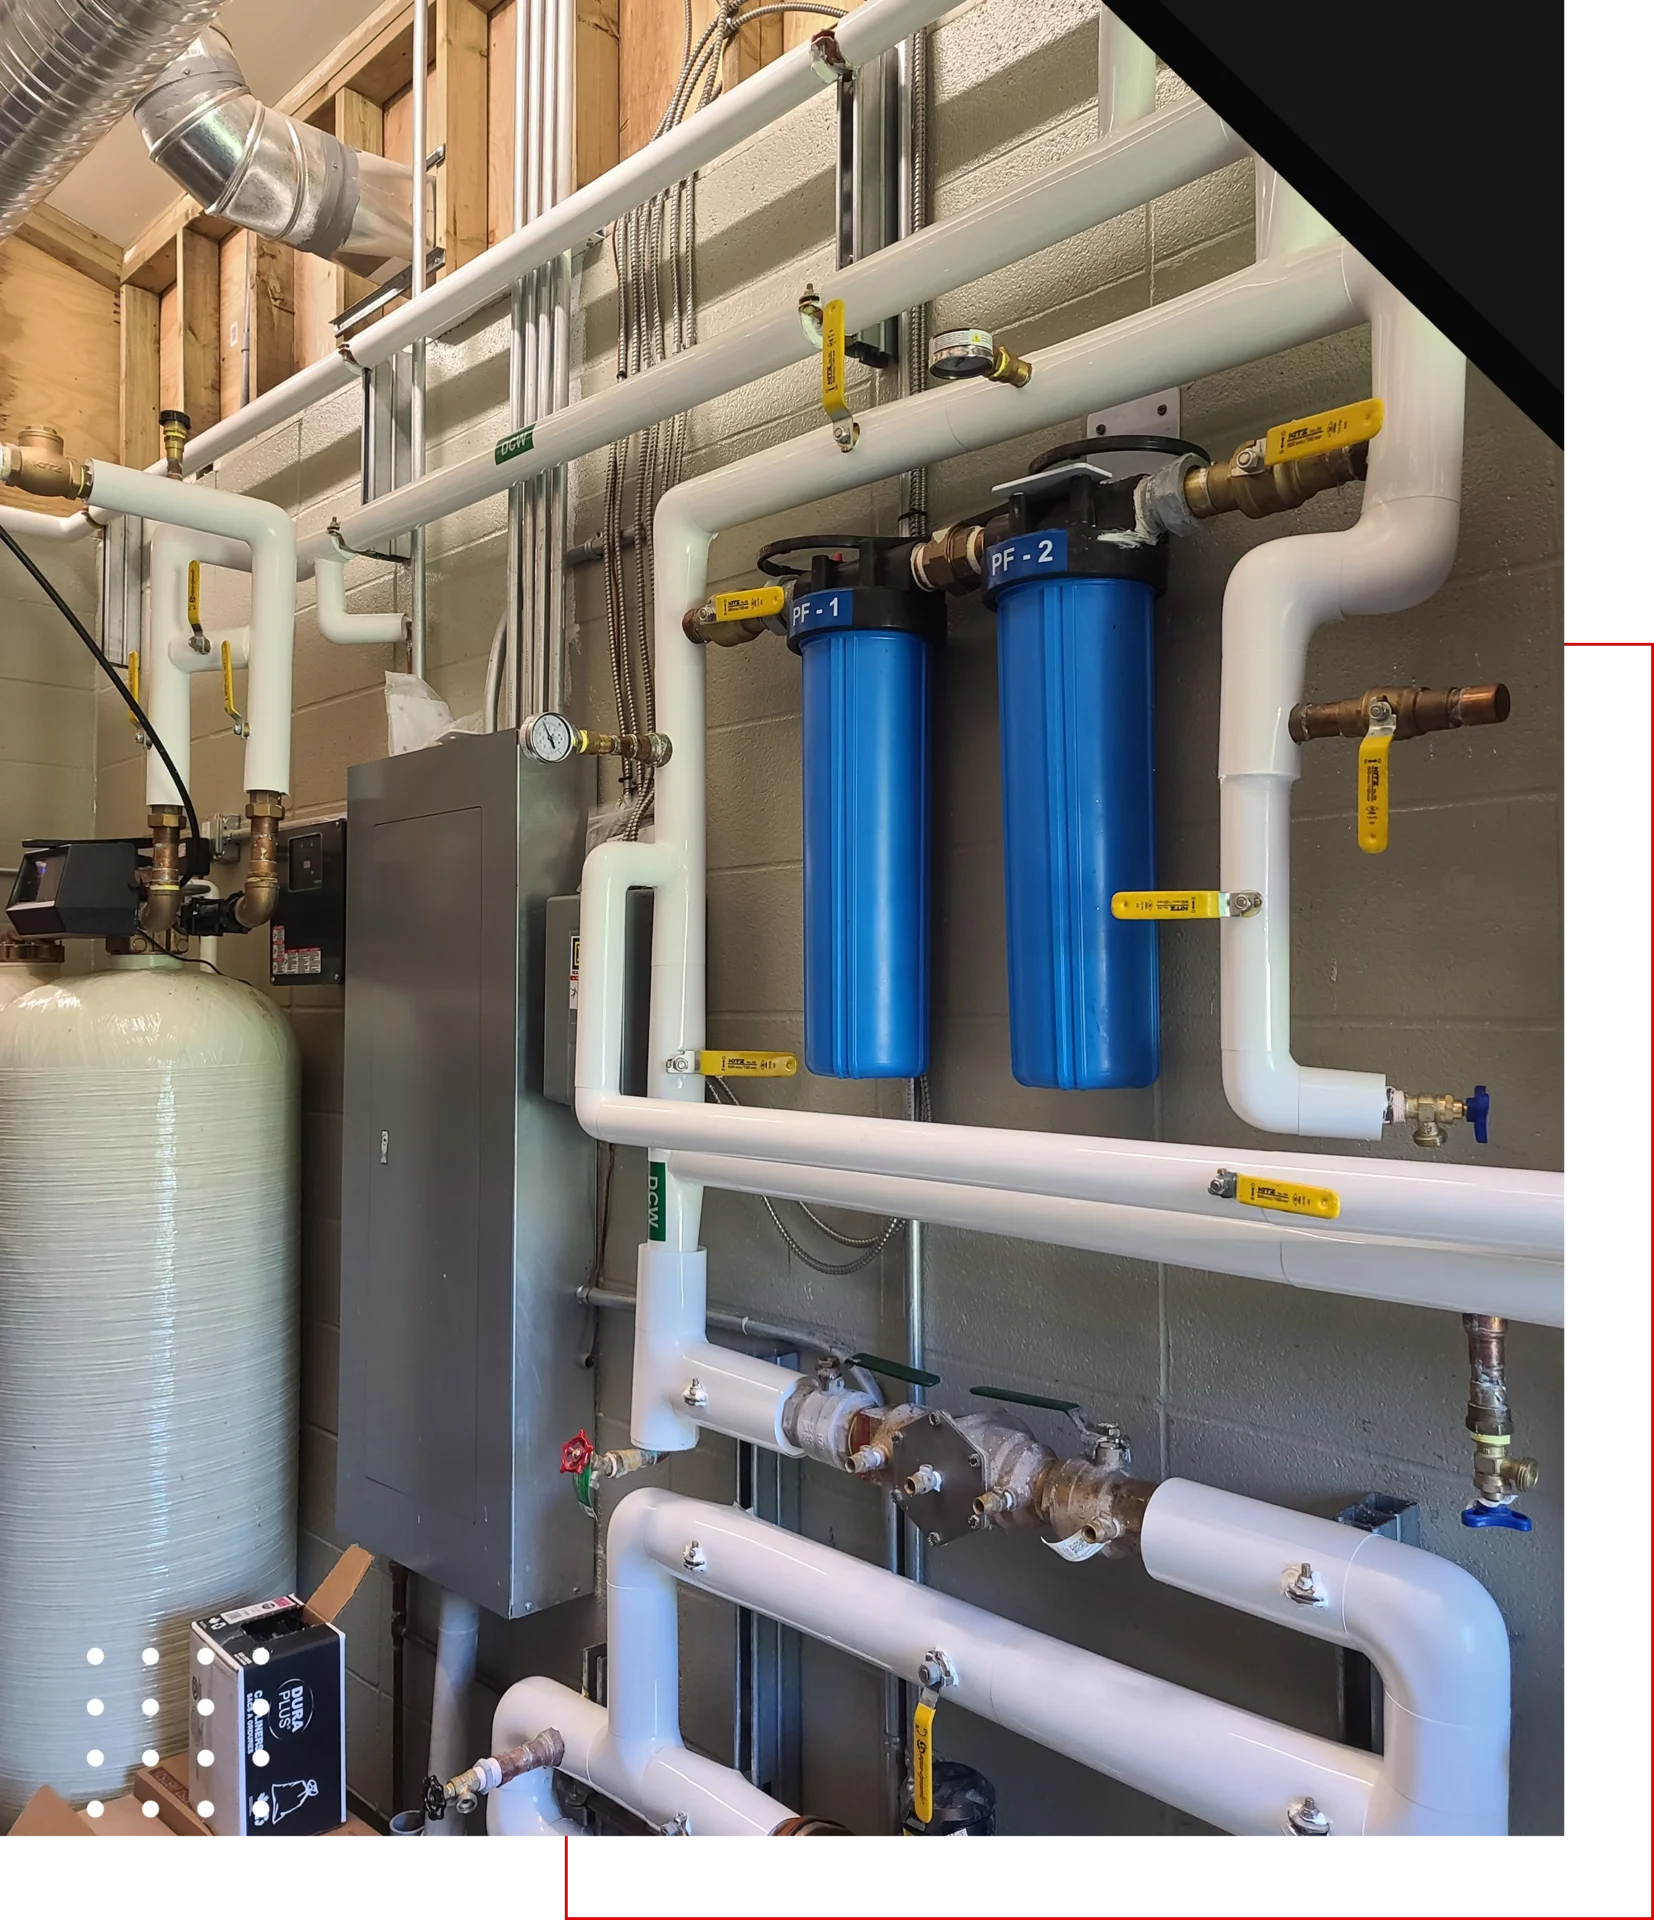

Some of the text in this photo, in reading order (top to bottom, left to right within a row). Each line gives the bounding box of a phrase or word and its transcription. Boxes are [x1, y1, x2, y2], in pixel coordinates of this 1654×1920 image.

[501, 432, 527, 456] DCW
[1288, 427, 1308, 440] KITZ
[991, 547, 1015, 577] PF
[1038, 539, 1053, 563] 2
[793, 602, 811, 627] PF
[830, 597, 839, 617] 1
[1372, 766, 1380, 787] KITZ
[648, 1175, 659, 1229] DCW
[1257, 1186, 1276, 1195] KITZ
[291, 1685, 304, 1733] DURA
[254, 1715, 264, 1751] LINERS
